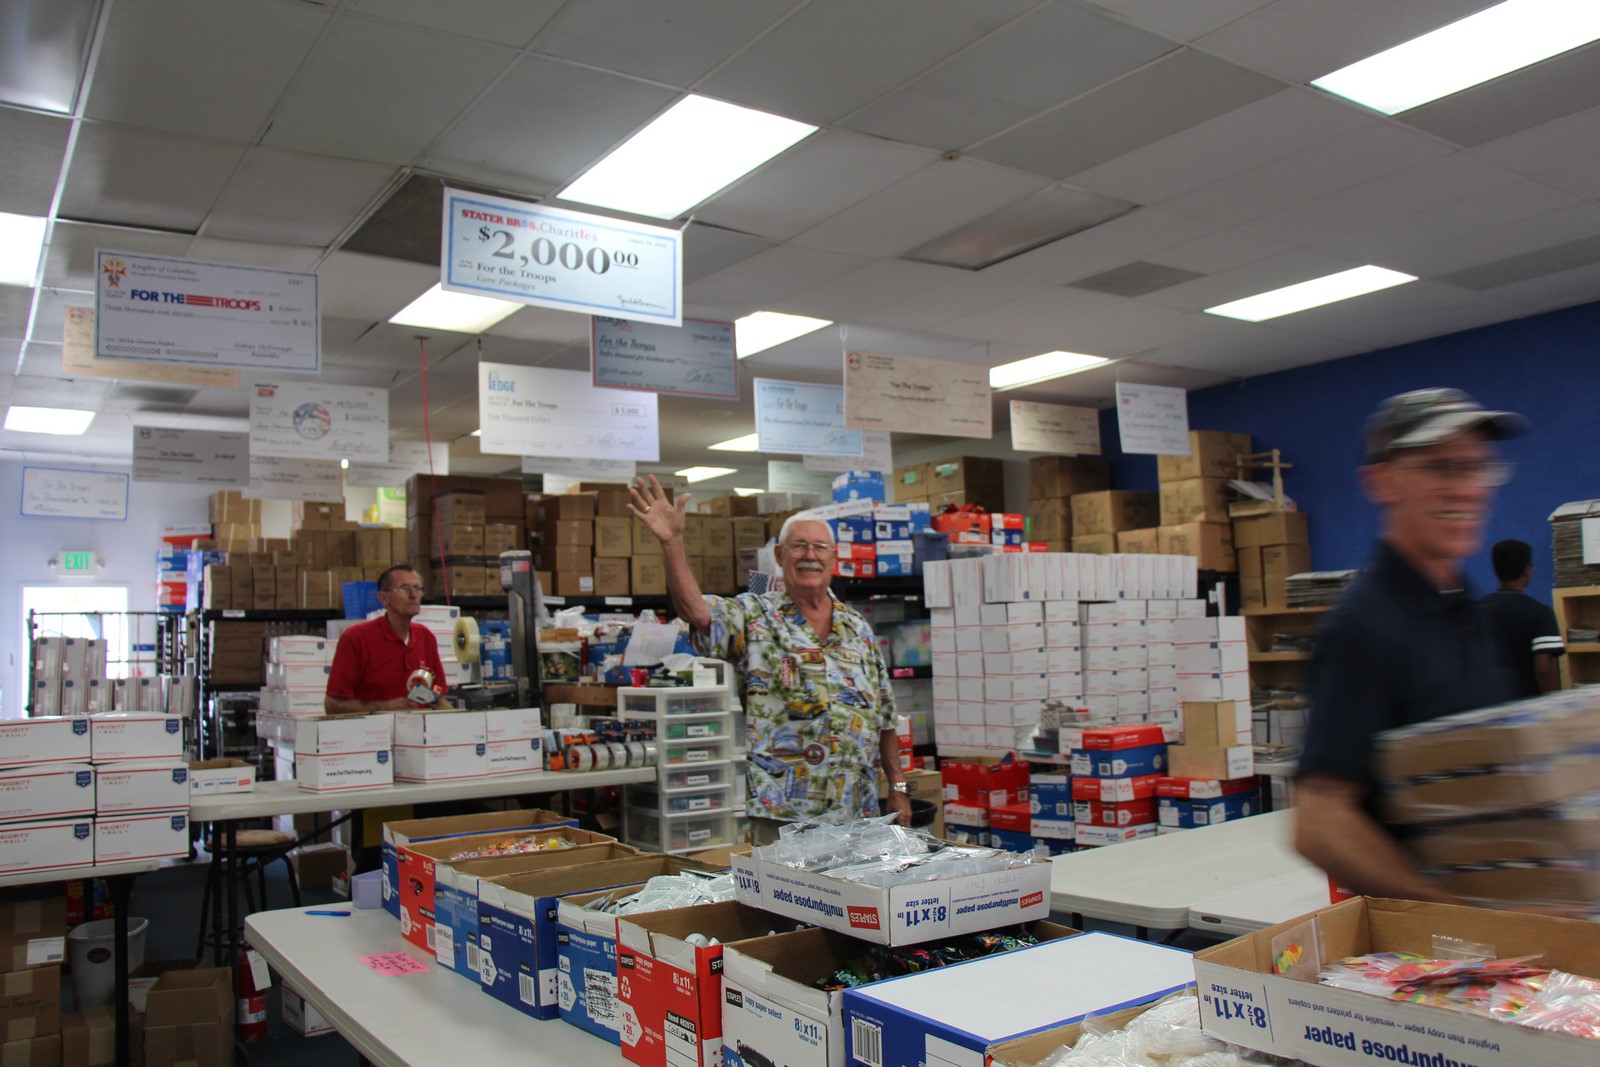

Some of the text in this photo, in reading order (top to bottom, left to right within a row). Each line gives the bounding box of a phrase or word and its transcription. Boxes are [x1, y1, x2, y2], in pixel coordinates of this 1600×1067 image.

[462, 208, 504, 225] STATER
[539, 222, 598, 242] Charities
[132, 263, 157, 273] Knights
[167, 266, 197, 276] Columbus
[477, 262, 497, 273] For
[499, 266, 516, 277] the
[519, 269, 557, 284] Troops
[476, 274, 536, 291] Care Packages
[130, 289, 261, 311] FOR THE TROOPS
[599, 335, 657, 352] For the Troops
[492, 380, 516, 392] EDGE
[65, 552, 91, 570] EXIT
[772, 889, 844, 918] multipurpose paper
[905, 896, 939, 909] letter size
[955, 897, 1019, 915] multipurpose paper
[1020, 894, 1042, 906] STAPLES
[491, 916, 507, 927] multipurpose
[849, 912, 878, 925] STAPLES
[558, 934, 569, 942] STAPLES
[569, 933, 597, 948] multipurpose paper
[620, 956, 634, 966] STAPLES
[635, 956, 654, 969] copy paper
[676, 985, 685, 994] letter
[1210, 983, 1254, 1003] letter size
[726, 991, 742, 1003] STAPLES
[744, 995, 783, 1020] copy paper select
[625, 1011, 632, 1023] 92
[626, 1024, 633, 1036] 20
[1287, 997, 1501, 1053] brighter than copy paper versatile for printers and copiers
[645, 1035, 654, 1045] white
[653, 1030, 663, 1041] sheets
[798, 1033, 818, 1047] letter size
[1303, 1025, 1357, 1052] paper
